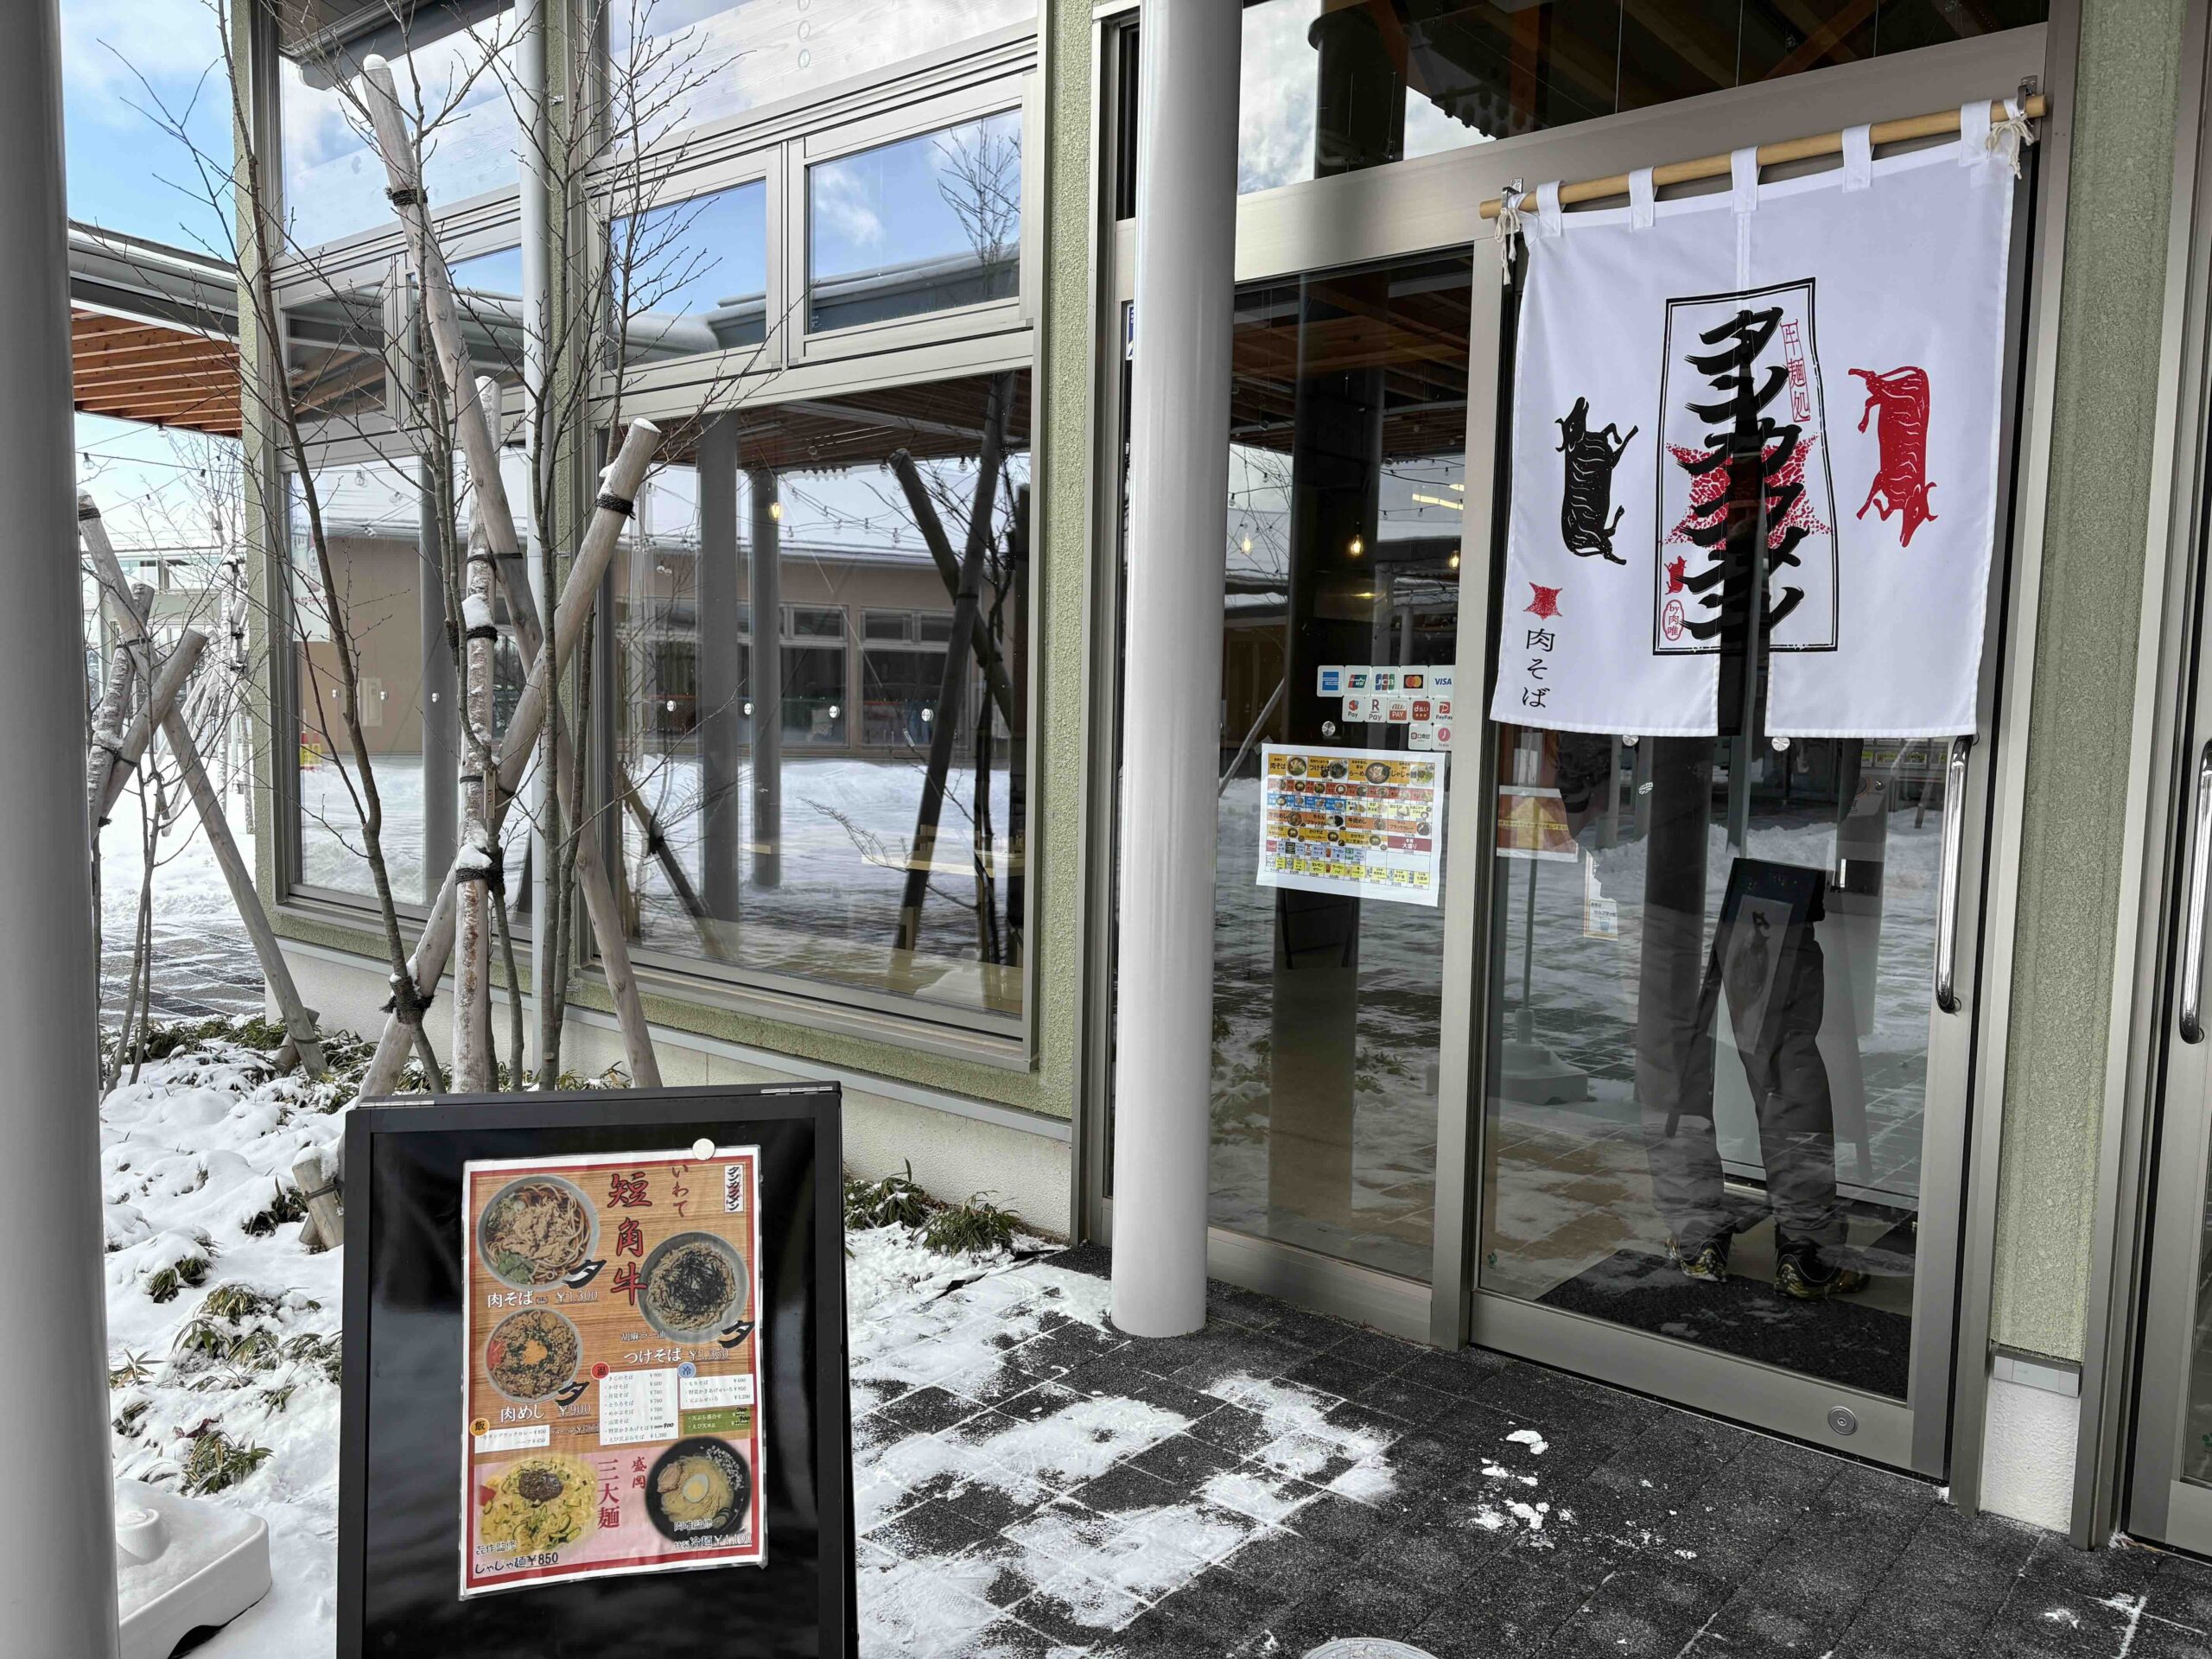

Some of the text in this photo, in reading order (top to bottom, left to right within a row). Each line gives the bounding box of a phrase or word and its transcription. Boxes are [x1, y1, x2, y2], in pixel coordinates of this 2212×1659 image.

[1522, 628, 1555, 708] 肉そば
[671, 1165, 690, 1217] いわて
[726, 1166, 740, 1211] タンカクメン
[607, 1172, 652, 1306] 短角牛
[487, 1291, 533, 1308] 肉そば
[556, 1289, 599, 1303] ¥1,300
[624, 1347, 682, 1364] つけそば
[683, 1366, 691, 1376] 冷
[500, 1404, 591, 1422] 肉めし ¥900
[475, 1421, 485, 1431] 飯
[598, 1459, 620, 1529] 三大麺
[475, 1552, 559, 1573] じゃじゃ麺 ¥850
